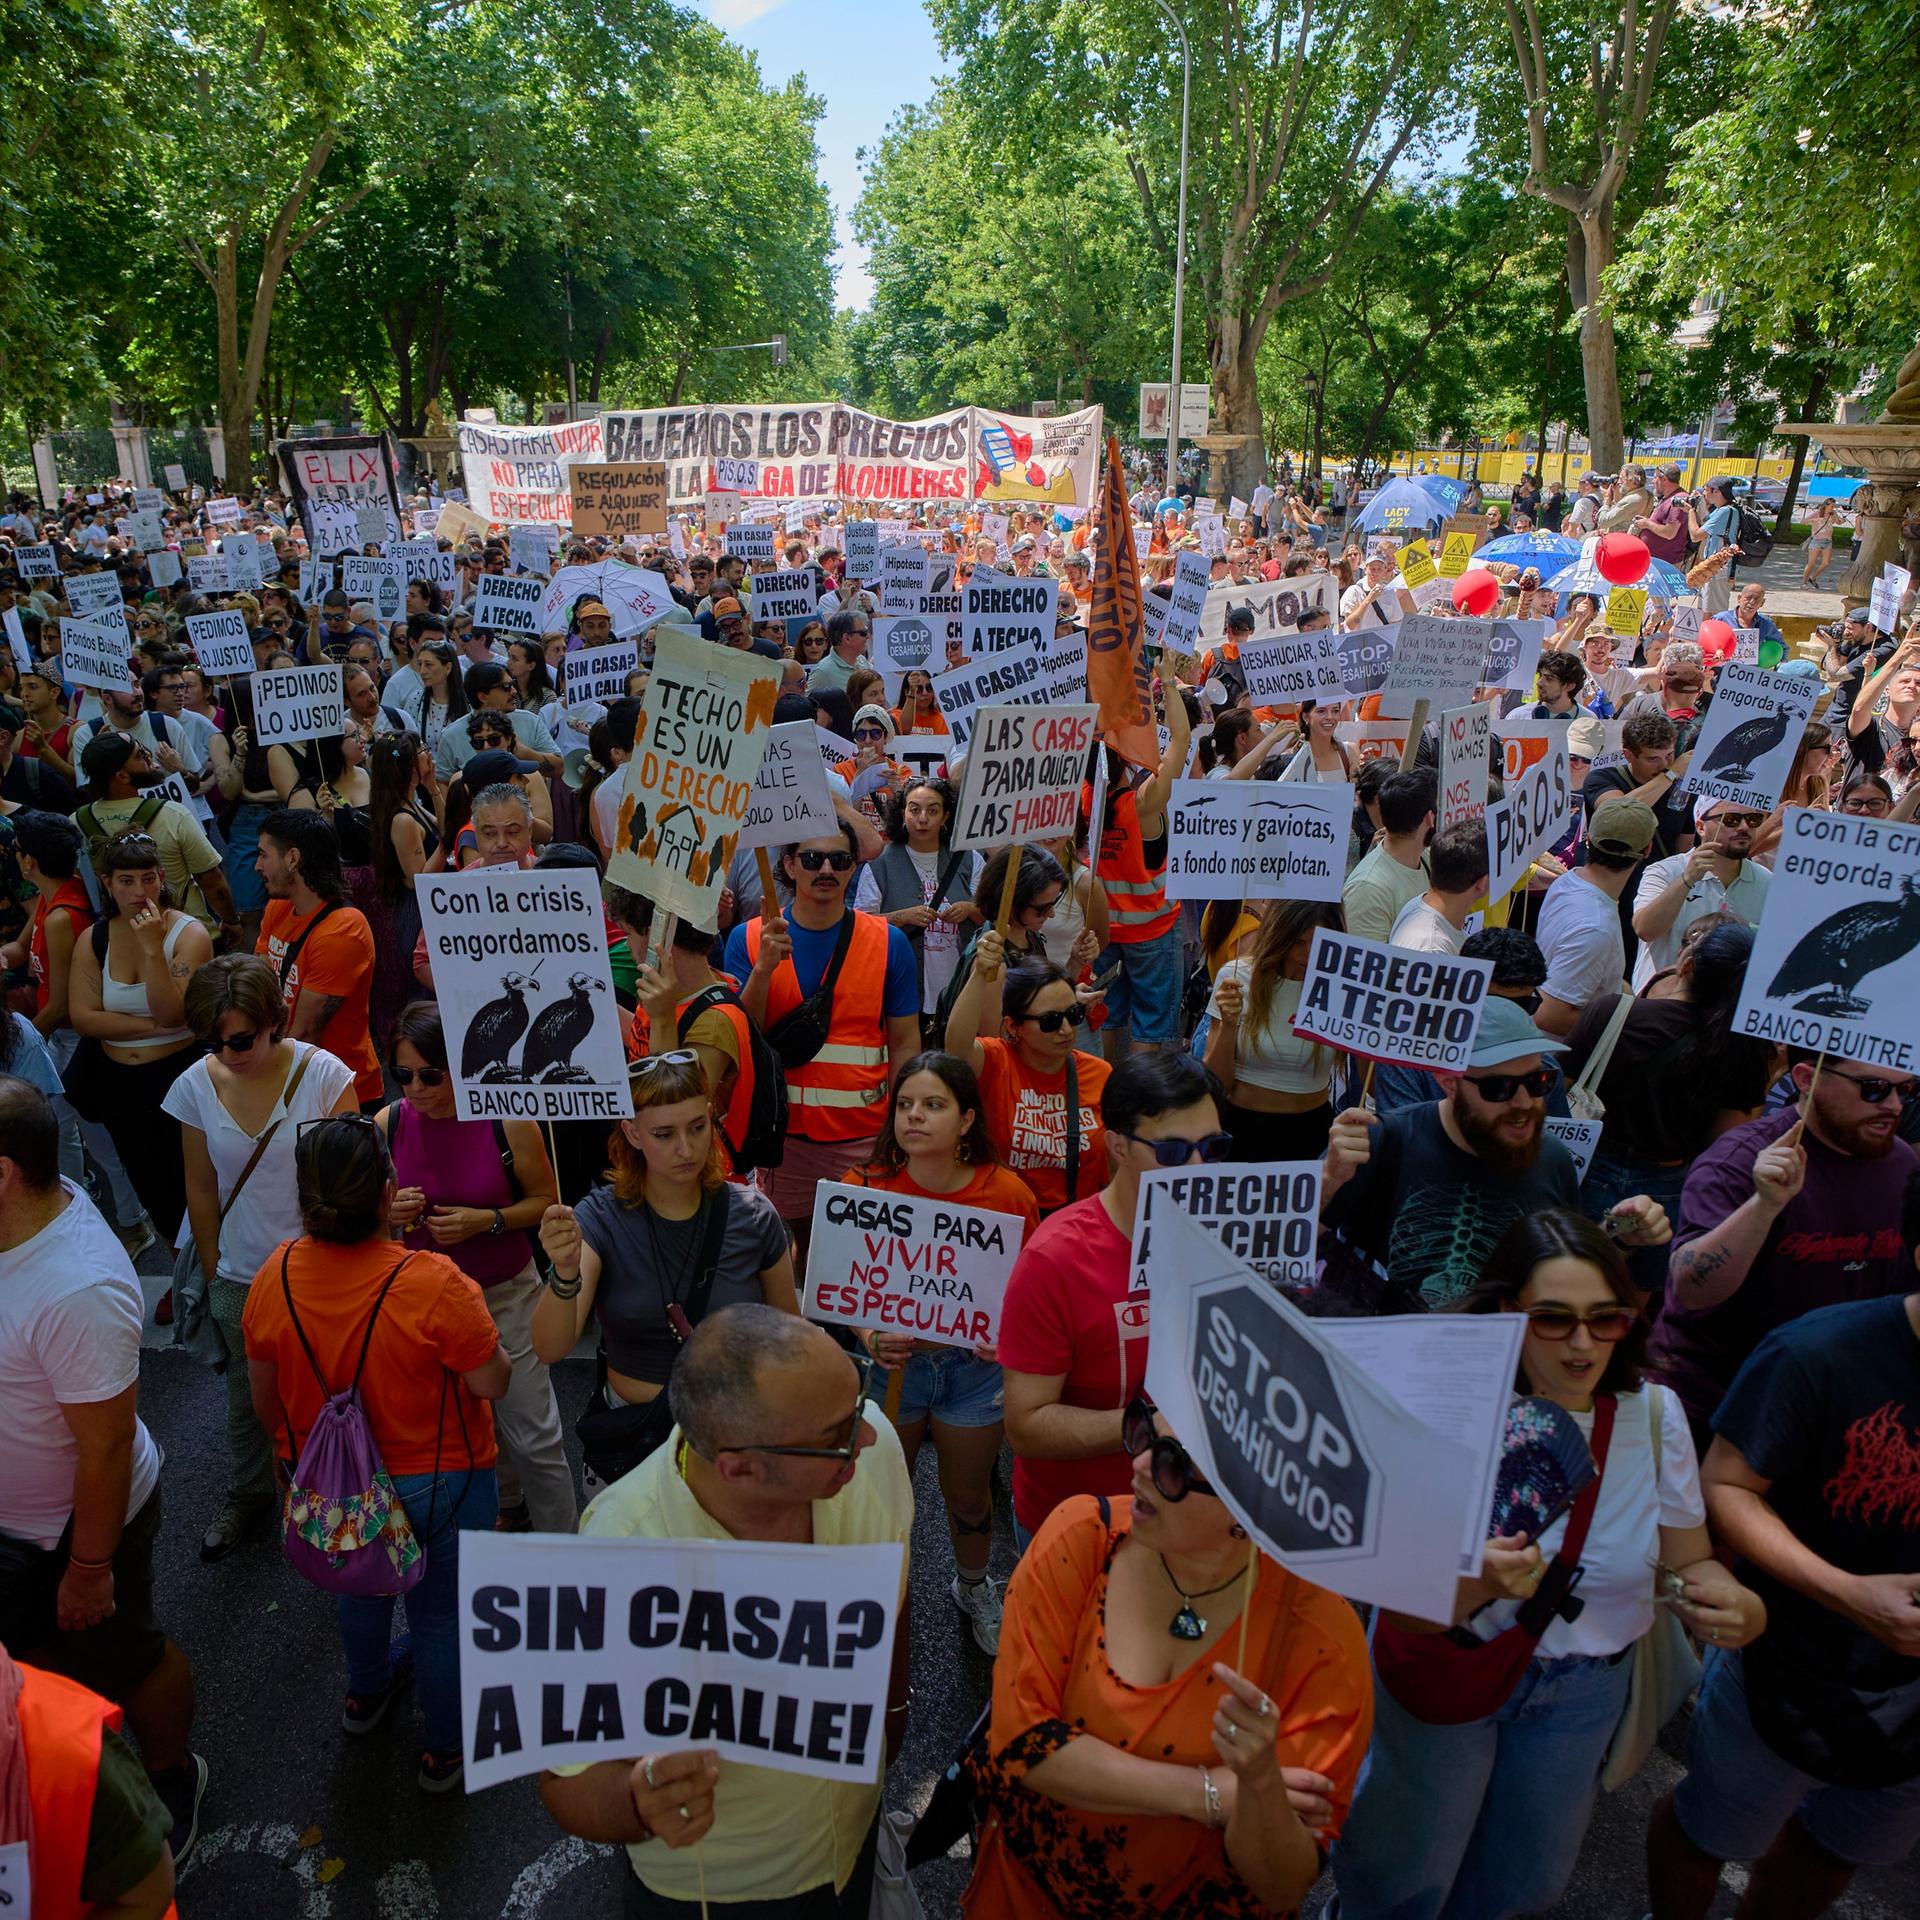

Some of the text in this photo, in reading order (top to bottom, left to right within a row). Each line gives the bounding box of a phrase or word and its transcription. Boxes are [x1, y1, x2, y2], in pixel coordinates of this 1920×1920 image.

[460, 425, 602, 455] CASAS PARA VIVIR
[606, 410, 969, 462] BAJEMOS LOS PRECIOS
[304, 453, 379, 484] ELIX
[490, 460, 563, 488] NO PARA
[577, 467, 667, 492] REGULACIÓN
[799, 464, 831, 497] DE
[833, 463, 968, 500] ALQUILERES
[575, 493, 661, 510] DE ALQUILER
[602, 512, 641, 532] YA!!!
[727, 530, 773, 541] SIN CASA?
[18, 548, 51, 559] DERECHO
[728, 545, 774, 556] A LA CALLE!
[23, 566, 30, 576] A
[346, 560, 393, 576] ¡PEDIMOS
[851, 561, 874, 573] estás?
[78, 588, 90, 597] ser
[344, 579, 358, 592] LO
[482, 578, 541, 602] DERECHO
[755, 574, 809, 594] DERECHO
[890, 576, 923, 590] alquileres
[760, 602, 769, 617] A
[770, 599, 812, 616] TECHO.
[884, 596, 908, 609] justos,
[968, 588, 1048, 614] DERECHO
[190, 616, 244, 646] ¡PEDIMOS
[480, 606, 536, 629] A TECHO.
[62, 628, 97, 652] ¡Fondos
[889, 644, 931, 657] DESAHUCIOS
[890, 630, 929, 643] STOP
[972, 627, 984, 652] A
[987, 626, 1047, 652] TECHO.
[1489, 637, 1518, 652] OP
[65, 652, 130, 682] CRIMINALES!
[211, 644, 253, 668] JUSTO!
[566, 653, 637, 680] SIN CASA?
[1241, 635, 1334, 671] DESAHUCIAR, SÍ:
[1338, 644, 1388, 667] STOP
[1481, 655, 1516, 668] HUCIOS
[938, 681, 976, 713] SIN
[975, 656, 1039, 699] CASA?
[1250, 667, 1340, 697] A BANCOS & Cía.
[1342, 660, 1391, 682] ESAHUCIOS
[1726, 663, 1814, 702] Con la crisis,
[257, 671, 338, 707] ¡PEDIMOS
[568, 678, 625, 704] A LA CALL
[1719, 686, 1775, 712] engorda
[656, 678, 742, 732] TECHO
[257, 704, 342, 736] LO JUSTO!
[951, 720, 968, 746] A
[984, 716, 1091, 752] LAS CASAS
[1450, 714, 1488, 742] NO NOS
[653, 716, 733, 771] ES UN
[1451, 739, 1487, 764] VAMOS.
[1593, 755, 1610, 767] Con
[640, 752, 751, 821] DERECHO
[980, 757, 1035, 797] PARA
[783, 795, 828, 822] DÍA...
[1446, 780, 1470, 808] NOS
[1687, 778, 1773, 811] BANCO BUITRE.
[965, 802, 1012, 840] LAS
[1173, 810, 1335, 845] Buitres y gaviotas,
[1495, 752, 1570, 878] PiS.O.S.
[1796, 813, 1844, 842] Con
[1855, 822, 1877, 848] la
[1171, 850, 1330, 880] a fondo nos explotan.
[1785, 854, 1893, 890] engorda
[430, 884, 592, 916] Con la crisis,
[439, 927, 599, 962] engordamos.
[1315, 938, 1486, 1005] DERECHO
[1305, 976, 1475, 1044] A TECHO
[1301, 1011, 1467, 1065] A JUSTO PRECIO!
[1744, 1008, 1914, 1071] BANCO BUITRE.
[468, 1089, 626, 1118] BANCO BUITRE.
[826, 1194, 1005, 1255] CASAS PARA
[864, 1233, 958, 1277] VIVIR
[849, 1260, 975, 1303] NO PARA
[816, 1283, 992, 1344] ESPECULAR
[1207, 1305, 1352, 1470] STOP
[1198, 1355, 1356, 1547] DESAHUCIOS
[472, 1584, 886, 1670] SIN CASA?
[473, 1677, 874, 1766] A LA CALLE!
